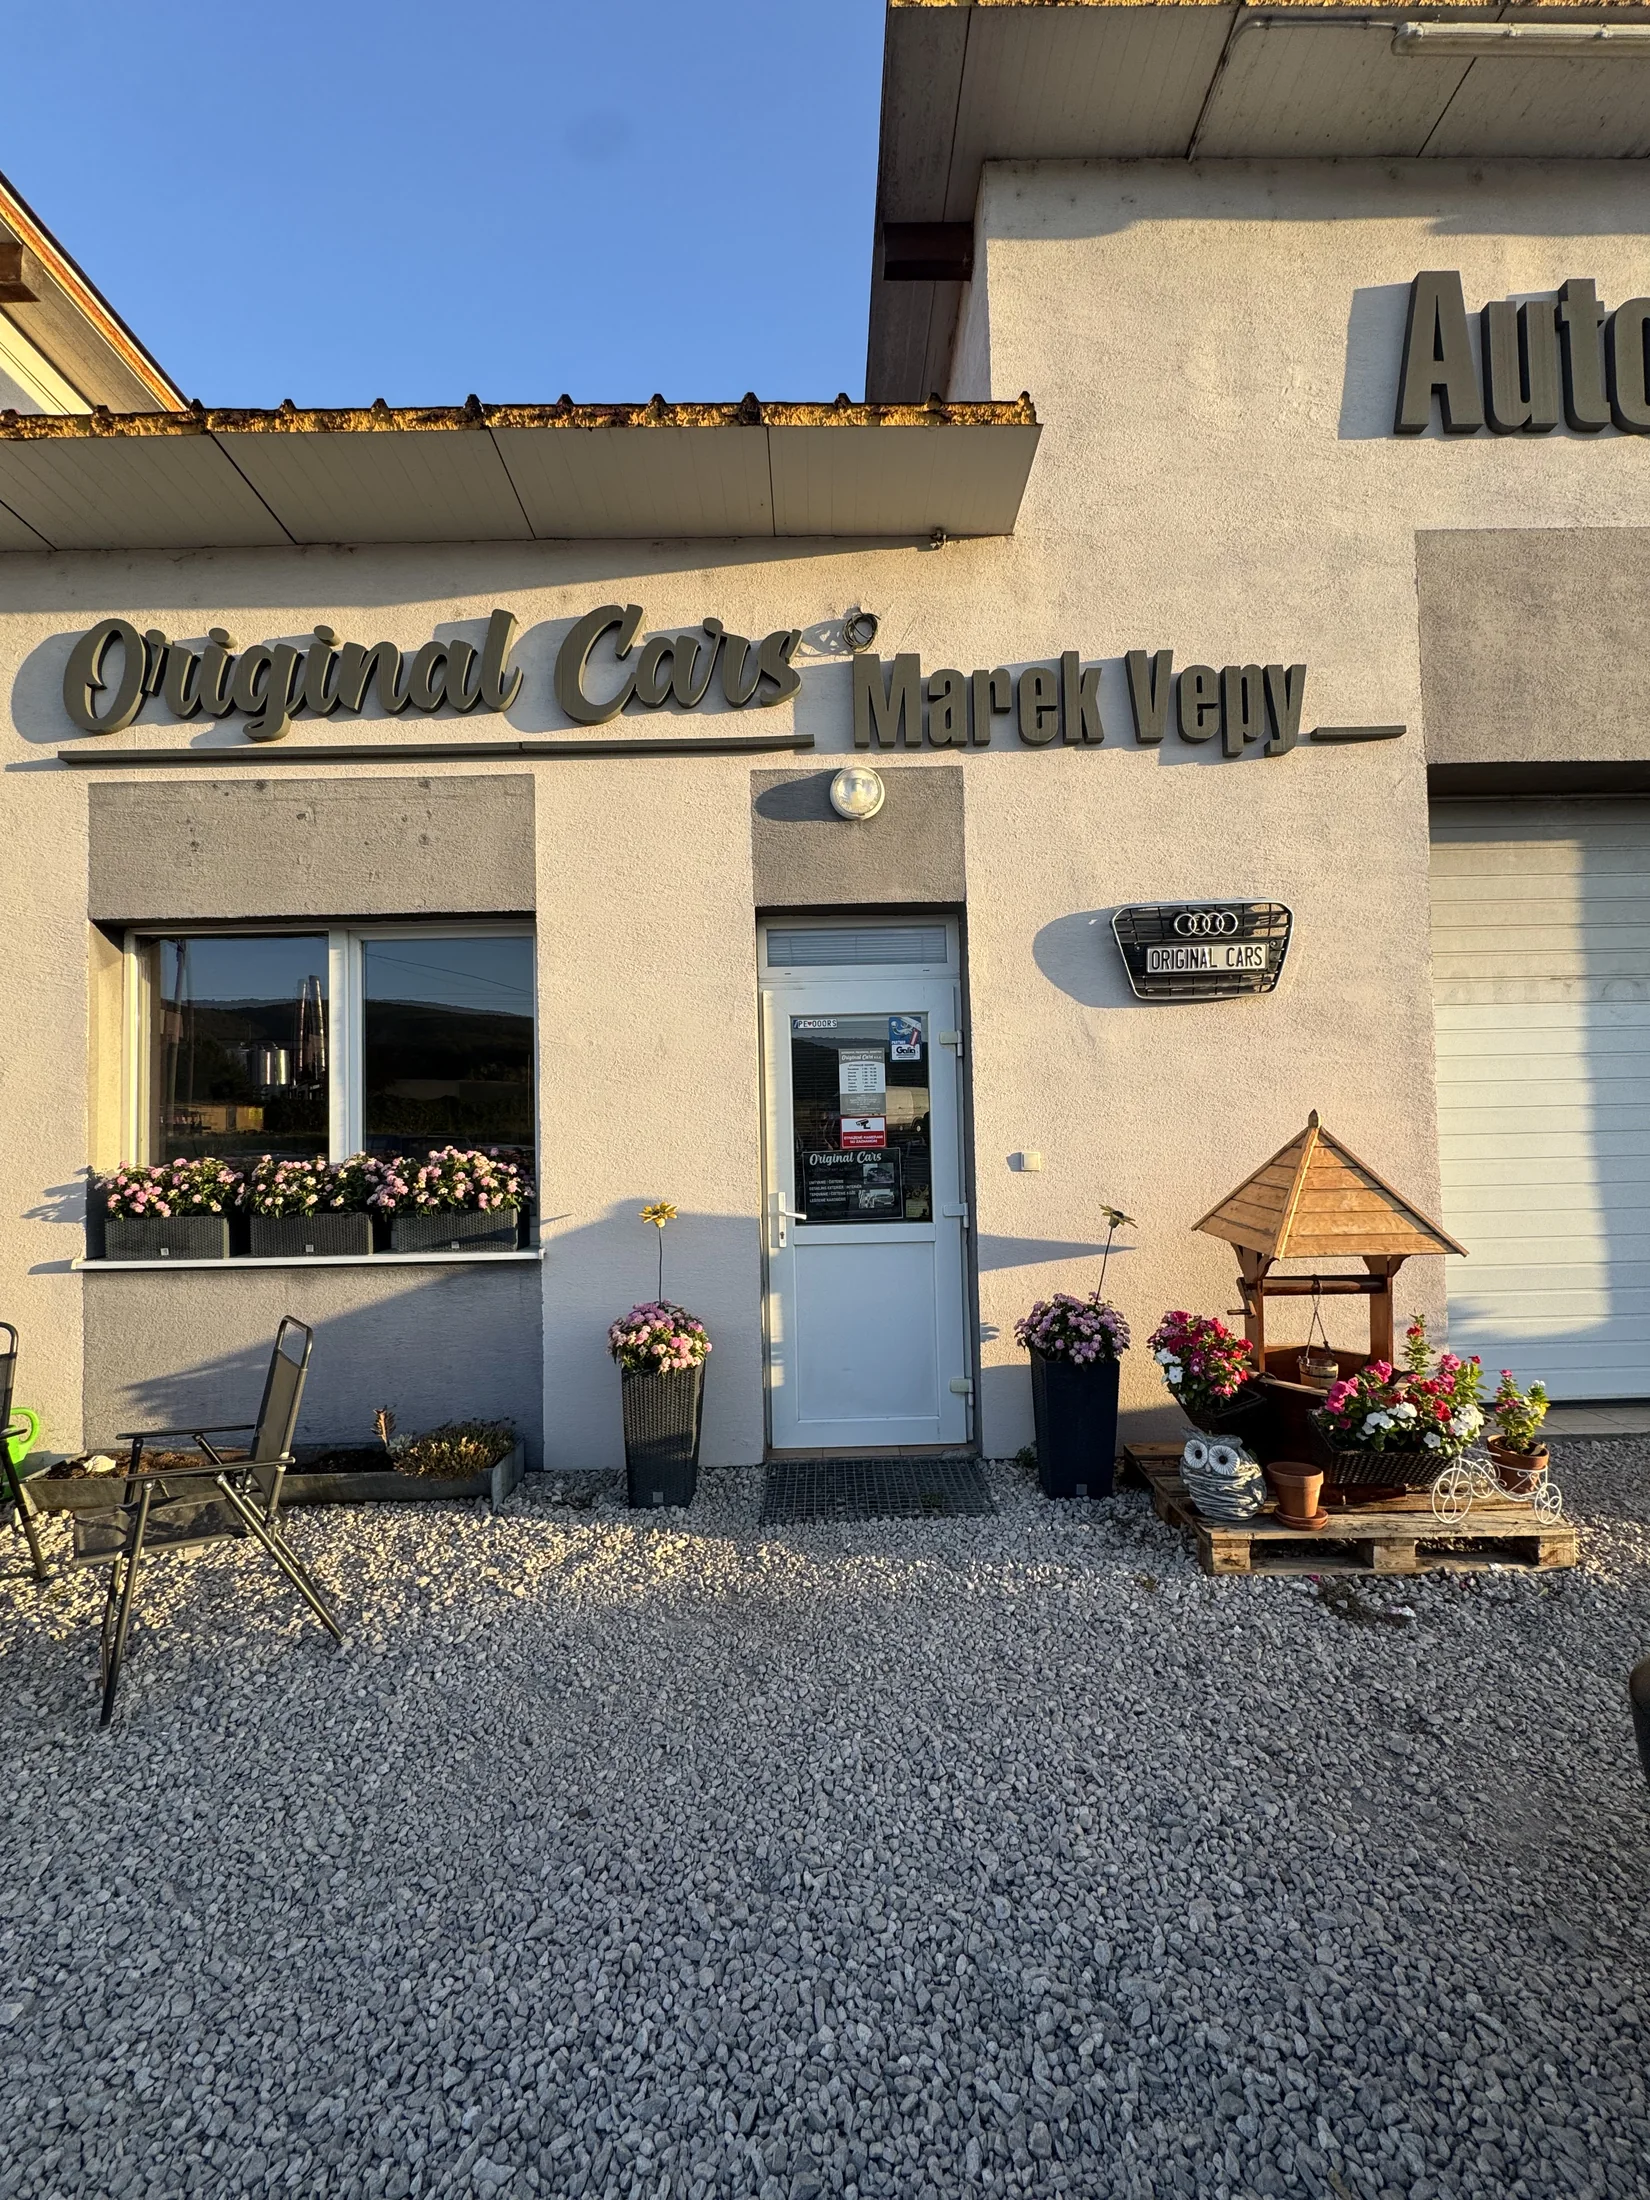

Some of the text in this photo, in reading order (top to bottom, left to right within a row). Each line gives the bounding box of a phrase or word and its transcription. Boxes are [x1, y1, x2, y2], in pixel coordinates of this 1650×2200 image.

[62, 603, 1307, 757] Original Cars Marek Vepy
[1151, 946, 1263, 970] ORIGINAL CARS
[809, 1151, 882, 1166] Original Cars
